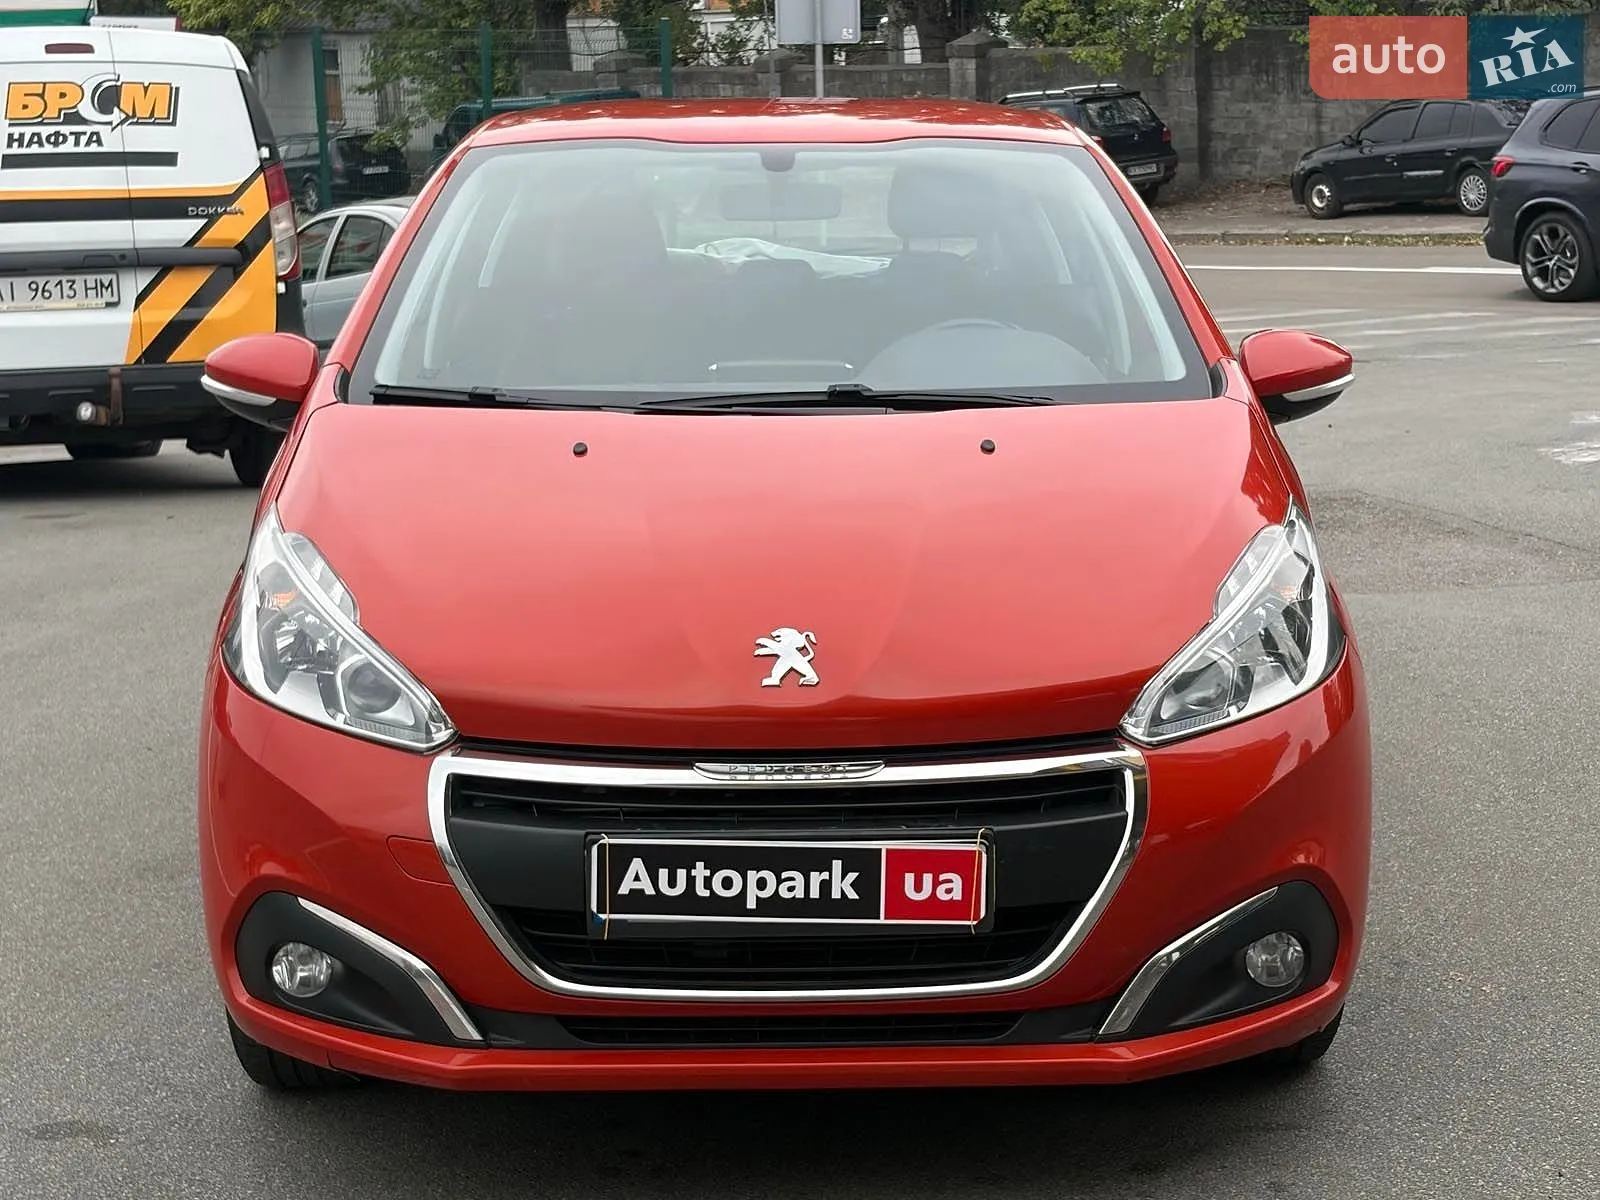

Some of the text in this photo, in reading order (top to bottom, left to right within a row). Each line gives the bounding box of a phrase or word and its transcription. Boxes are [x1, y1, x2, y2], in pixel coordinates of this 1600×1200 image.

[5, 73, 180, 132] БРСМ
[6, 130, 104, 149] НАФТА
[27, 279, 77, 302] 9613
[83, 277, 115, 299] HM
[616, 857, 964, 910] Autopark ua
